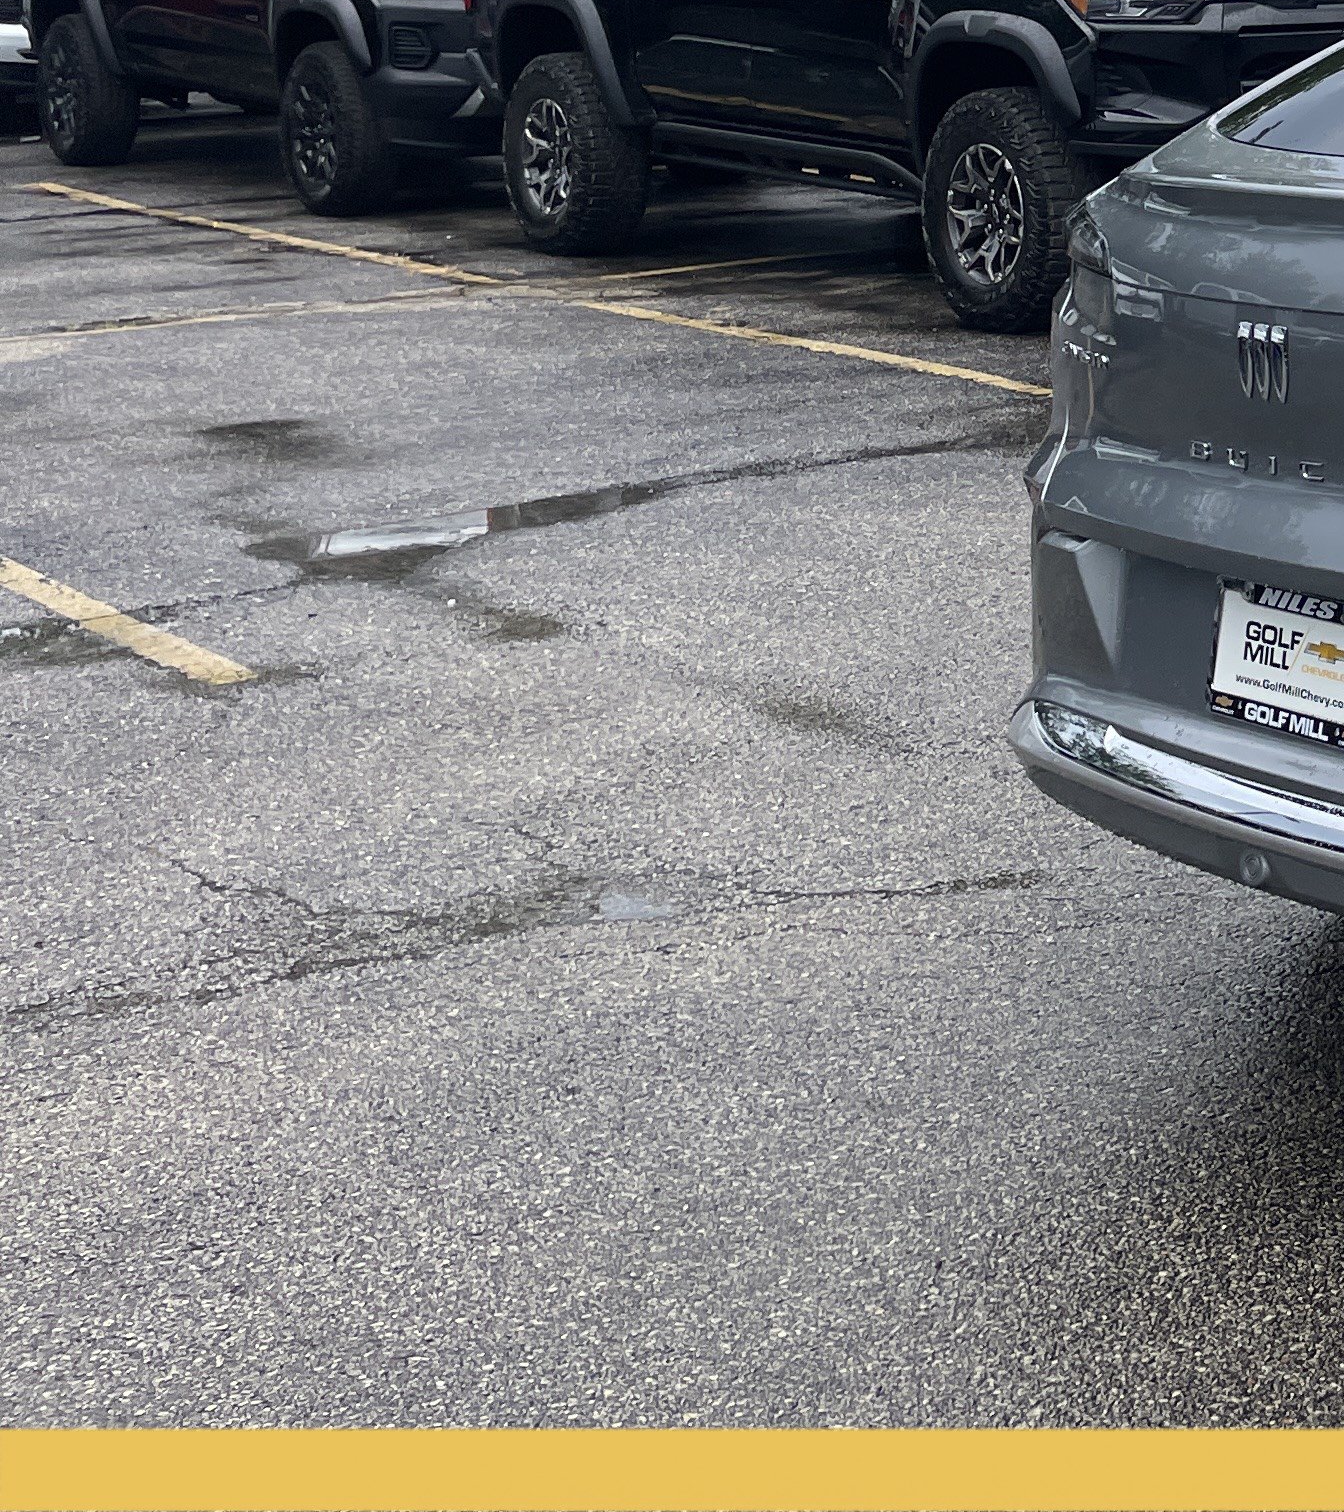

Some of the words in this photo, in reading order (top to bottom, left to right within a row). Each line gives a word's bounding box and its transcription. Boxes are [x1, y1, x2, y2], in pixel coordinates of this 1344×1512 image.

[1258, 587, 1338, 620] NILES
[1245, 620, 1305, 651] GOLF
[1243, 641, 1290, 671] MILL
[1244, 702, 1289, 729] GOLF
[1288, 714, 1330, 742] MILL
